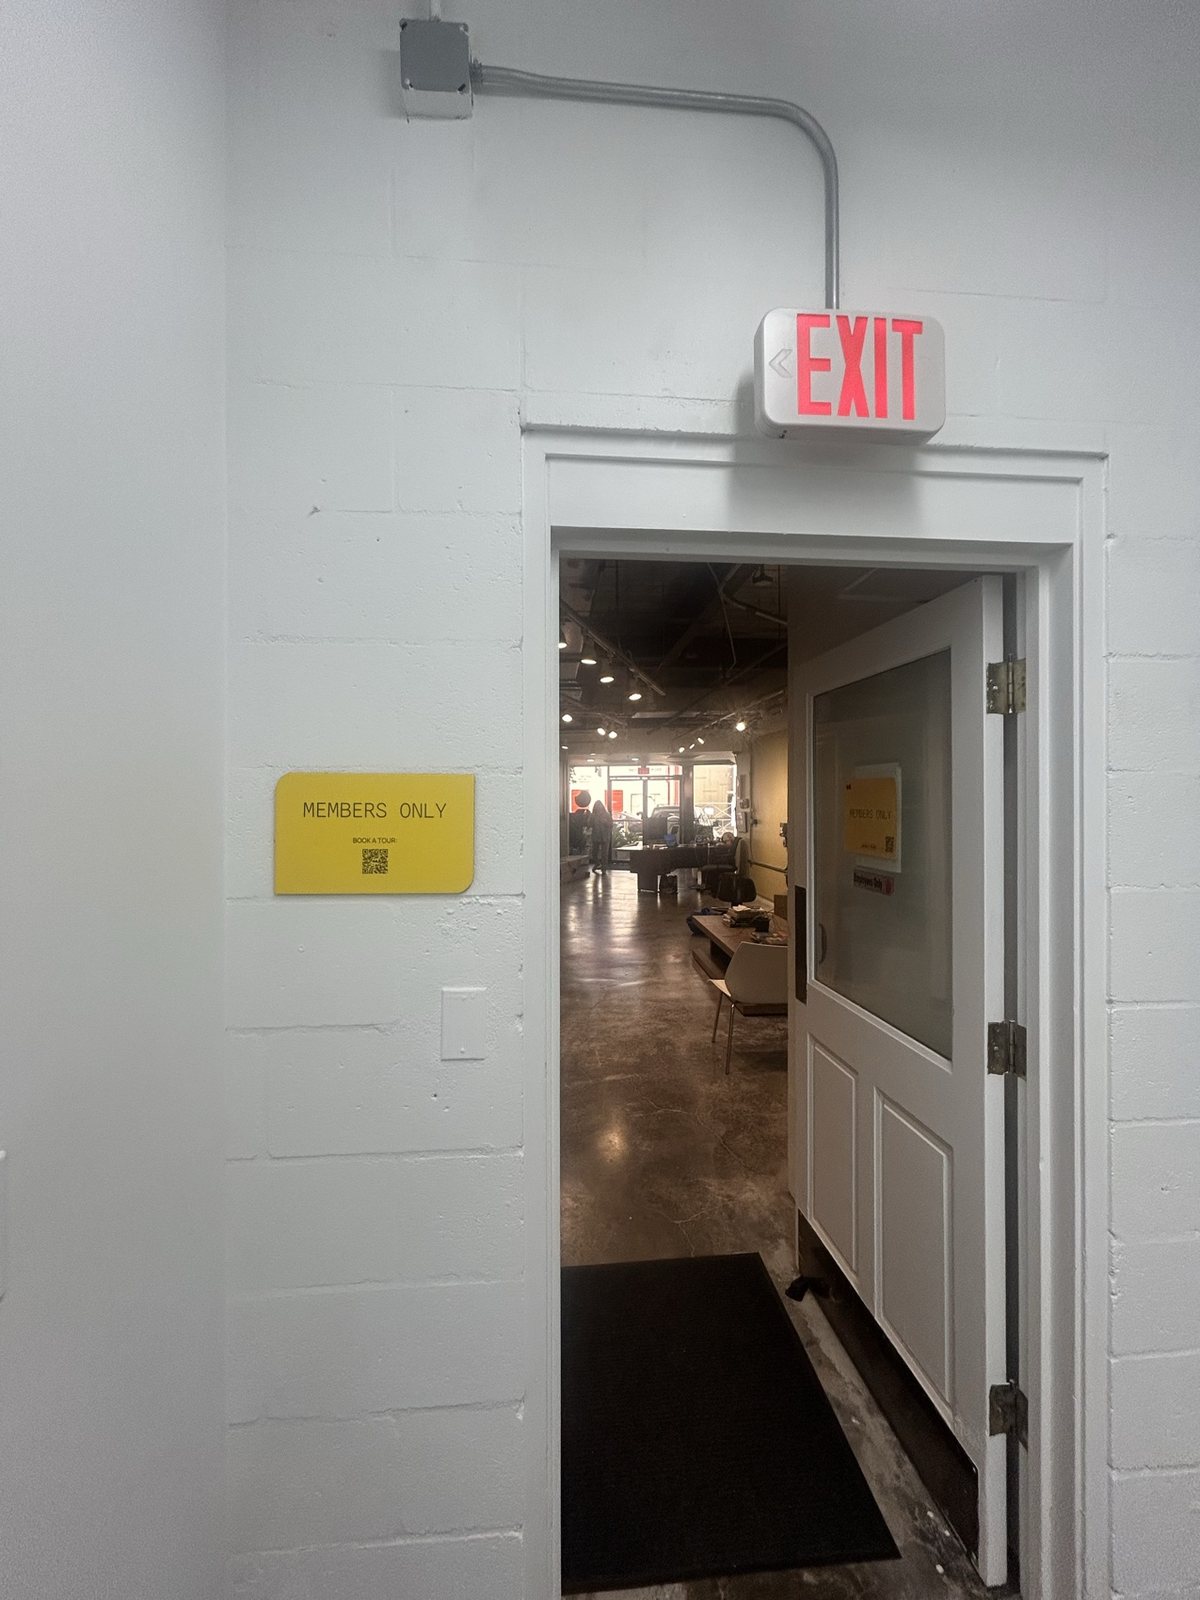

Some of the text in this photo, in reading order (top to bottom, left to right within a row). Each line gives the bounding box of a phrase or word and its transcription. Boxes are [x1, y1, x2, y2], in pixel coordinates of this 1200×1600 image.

[796, 313, 923, 421] EXIT
[303, 802, 447, 819] MEMBERS ONLY
